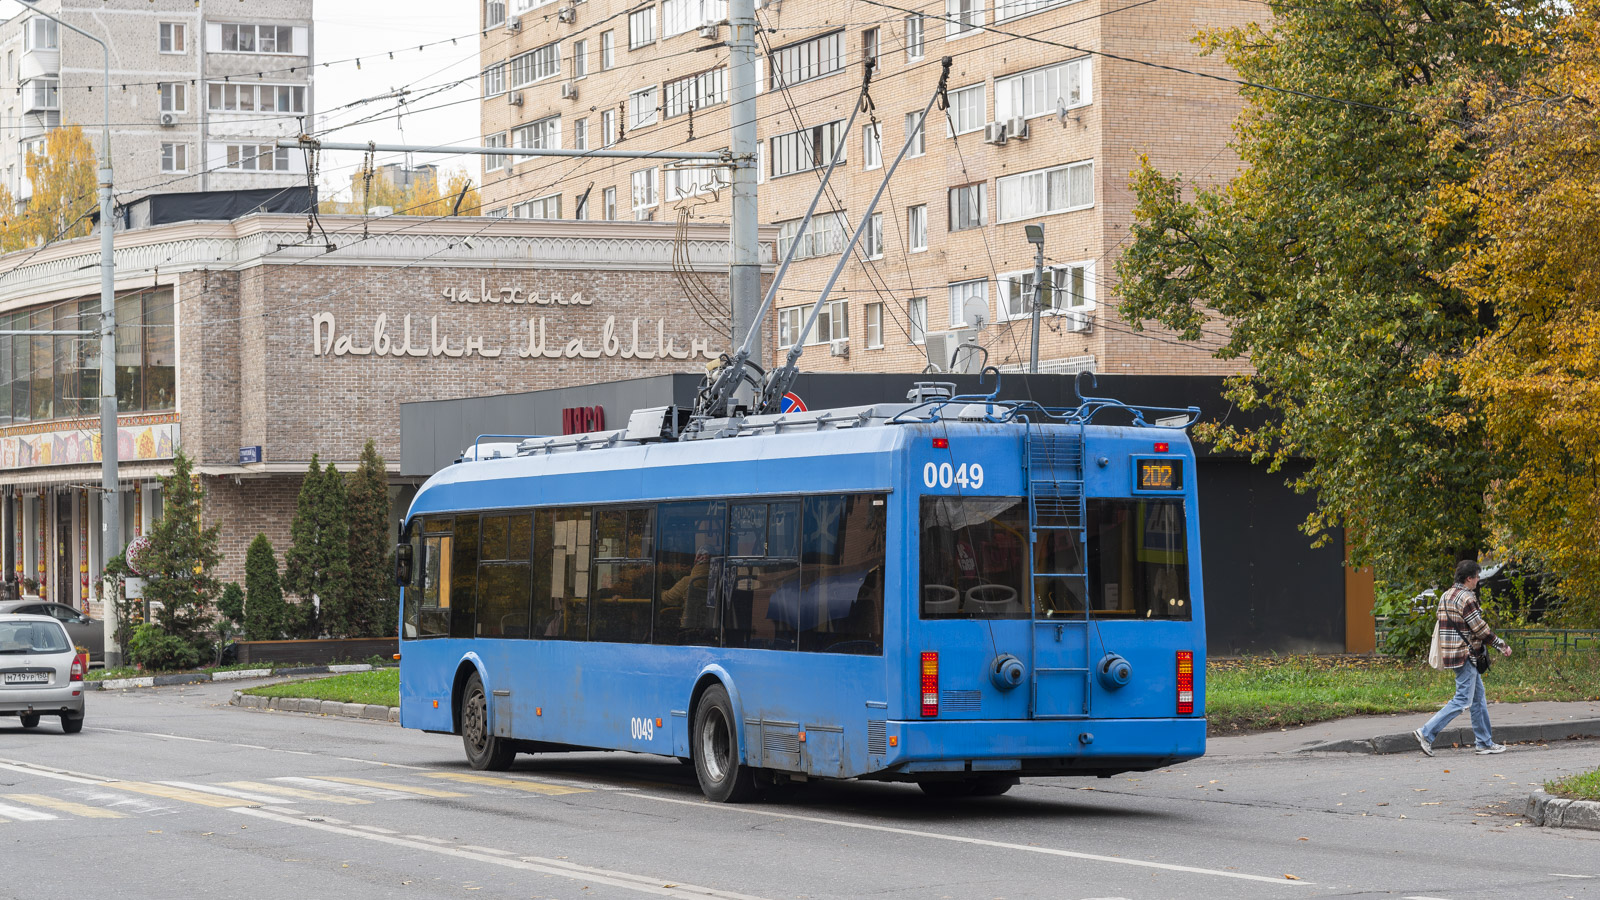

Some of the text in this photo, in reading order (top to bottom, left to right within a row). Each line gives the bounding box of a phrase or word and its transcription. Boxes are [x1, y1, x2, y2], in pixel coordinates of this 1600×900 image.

[311, 311, 502, 357] Павлин
[562, 405, 605, 435] МЯСО
[923, 462, 984, 490] 0049
[1142, 465, 1172, 486] 202
[631, 717, 653, 741] 0049
